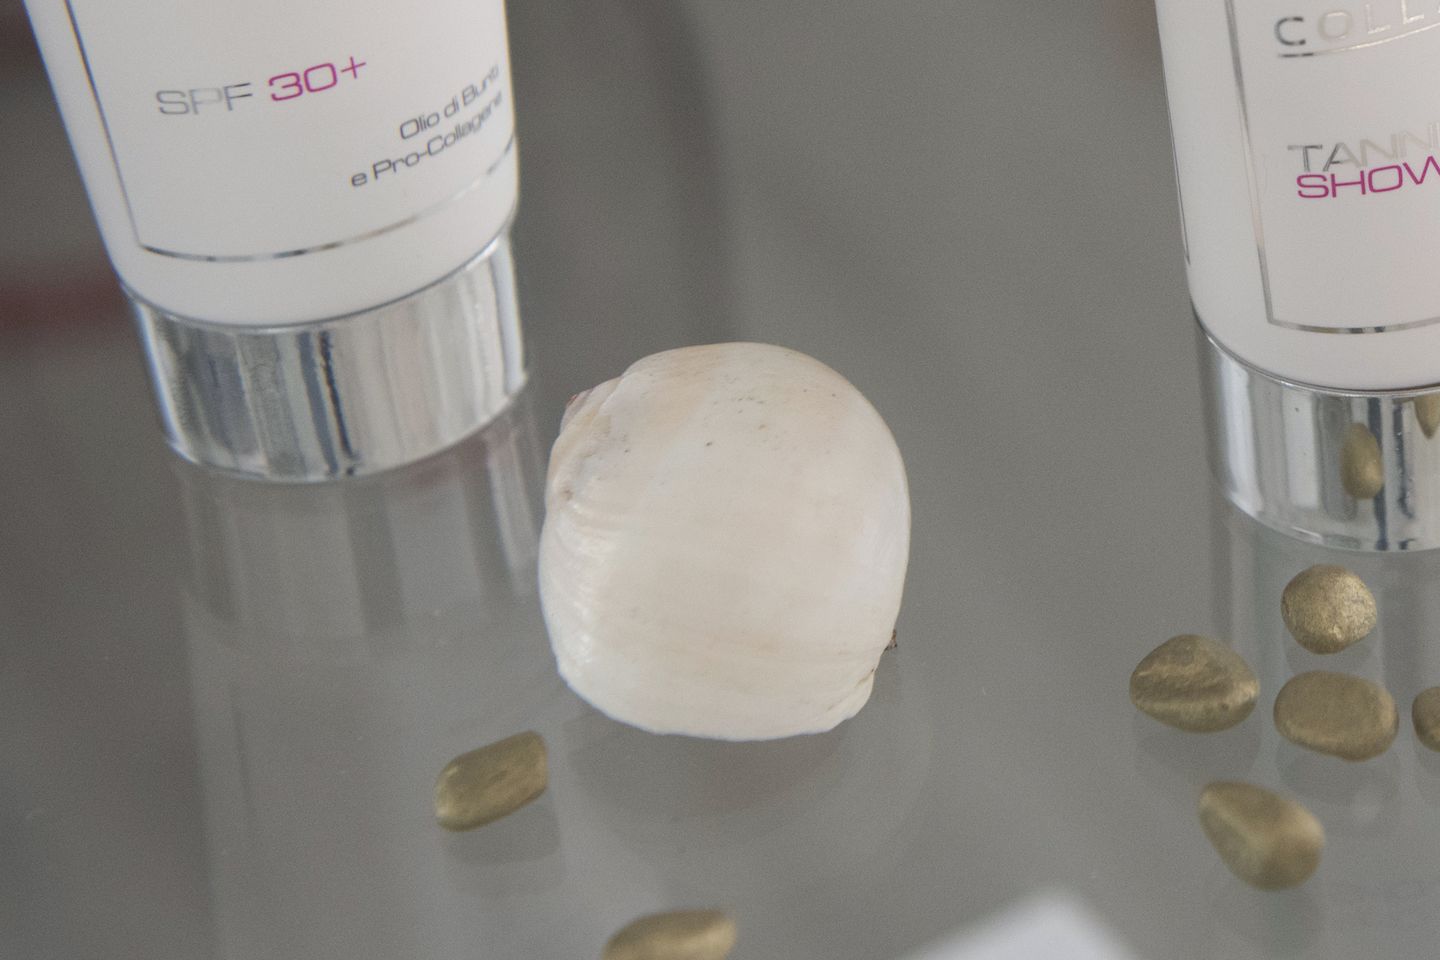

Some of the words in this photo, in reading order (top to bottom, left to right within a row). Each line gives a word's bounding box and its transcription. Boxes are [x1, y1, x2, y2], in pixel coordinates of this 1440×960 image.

[155, 82, 253, 116] SPF
[268, 56, 367, 102] 30+
[400, 111, 440, 140] Olio
[443, 93, 460, 118] di
[351, 172, 368, 187] e
